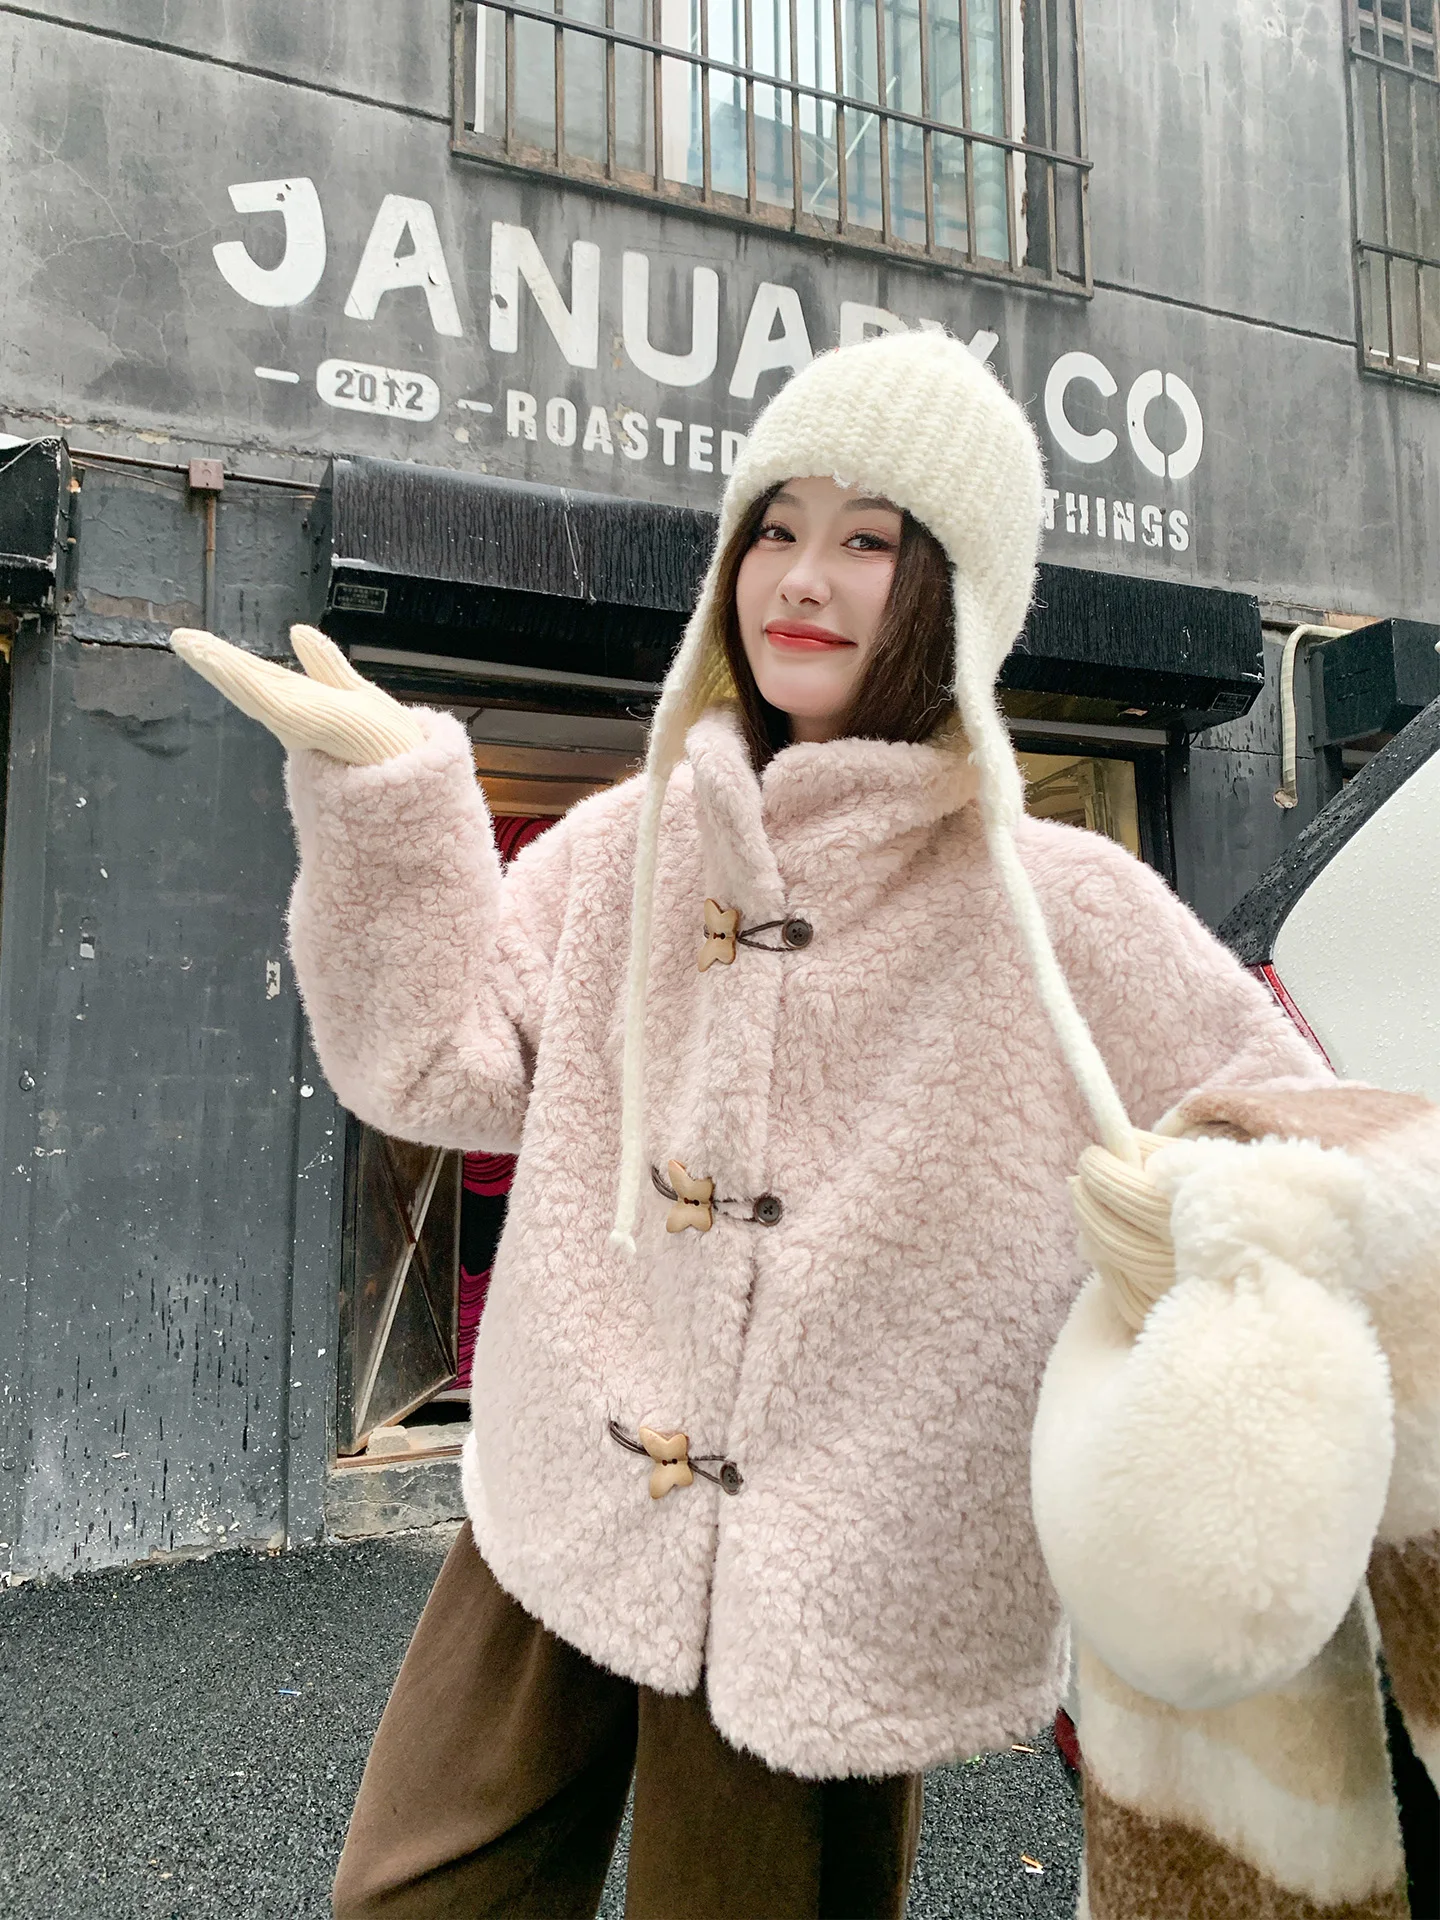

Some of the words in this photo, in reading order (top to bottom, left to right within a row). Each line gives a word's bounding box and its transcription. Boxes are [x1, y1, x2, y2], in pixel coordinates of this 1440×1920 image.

[212, 177, 1000, 400] JANUA
[1045, 351, 1204, 480] CO
[334, 369, 424, 411] 2012
[506, 389, 751, 476] ROASTED
[1040, 487, 1190, 552] THINGS
